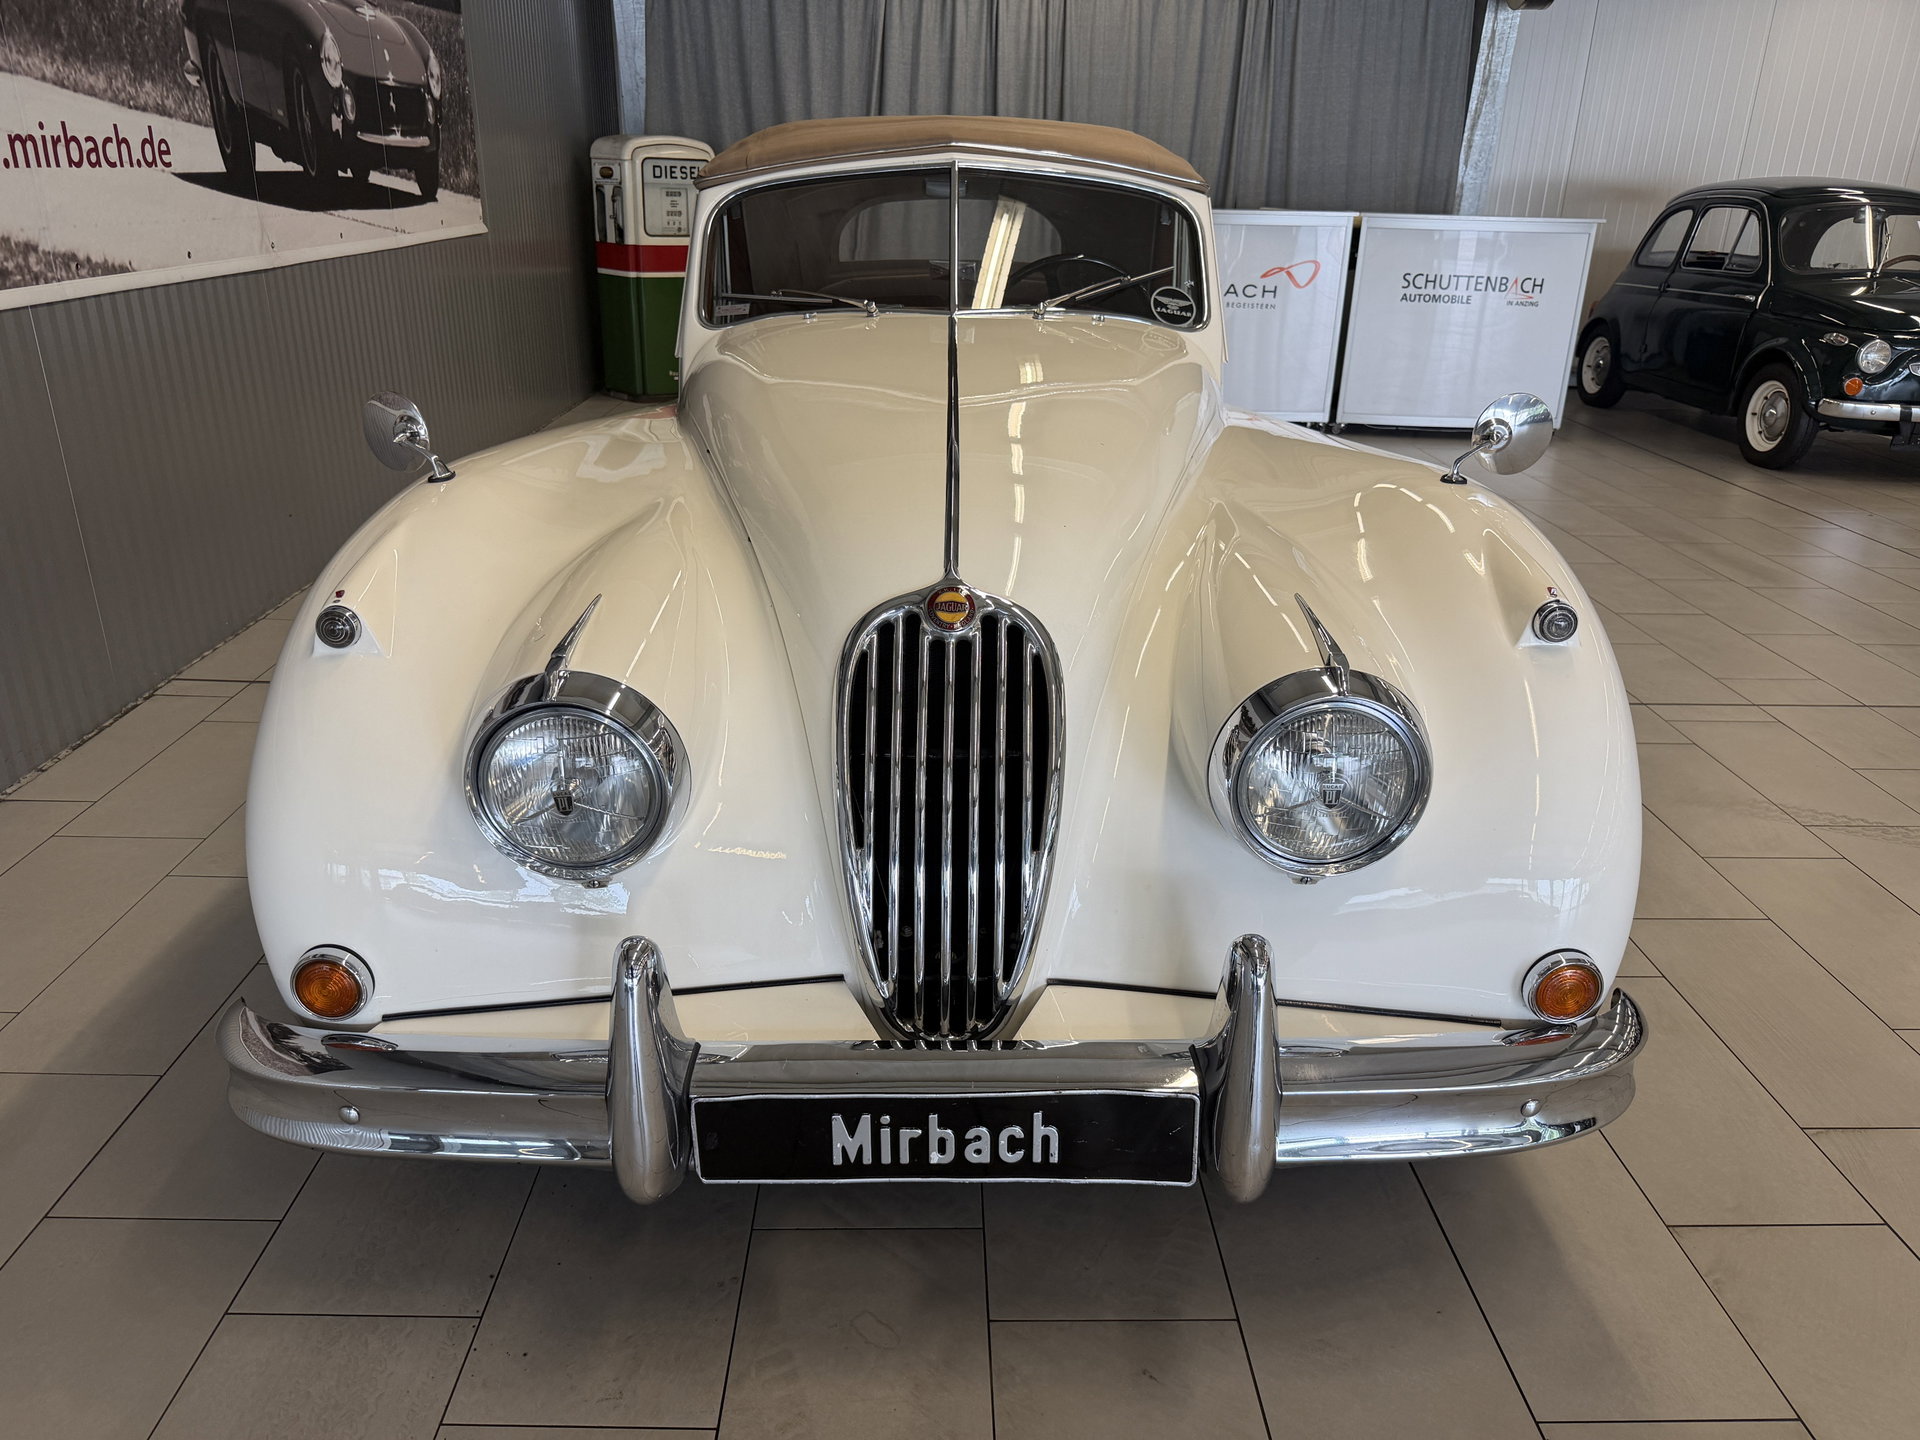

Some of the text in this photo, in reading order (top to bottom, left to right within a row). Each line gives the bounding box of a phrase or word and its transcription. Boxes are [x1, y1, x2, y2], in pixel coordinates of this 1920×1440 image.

[2, 120, 173, 169] .mirbach.de
[1401, 272, 1545, 297] SCHUTTENBACH
[1399, 292, 1472, 305] AUTOMOBILE
[1514, 300, 1539, 308] ANZING
[1225, 301, 1277, 310] BEGEISTERN
[1156, 307, 1192, 317] JAGUAR
[936, 602, 967, 612] JAGUAR
[831, 1110, 1060, 1166] Mirbach
